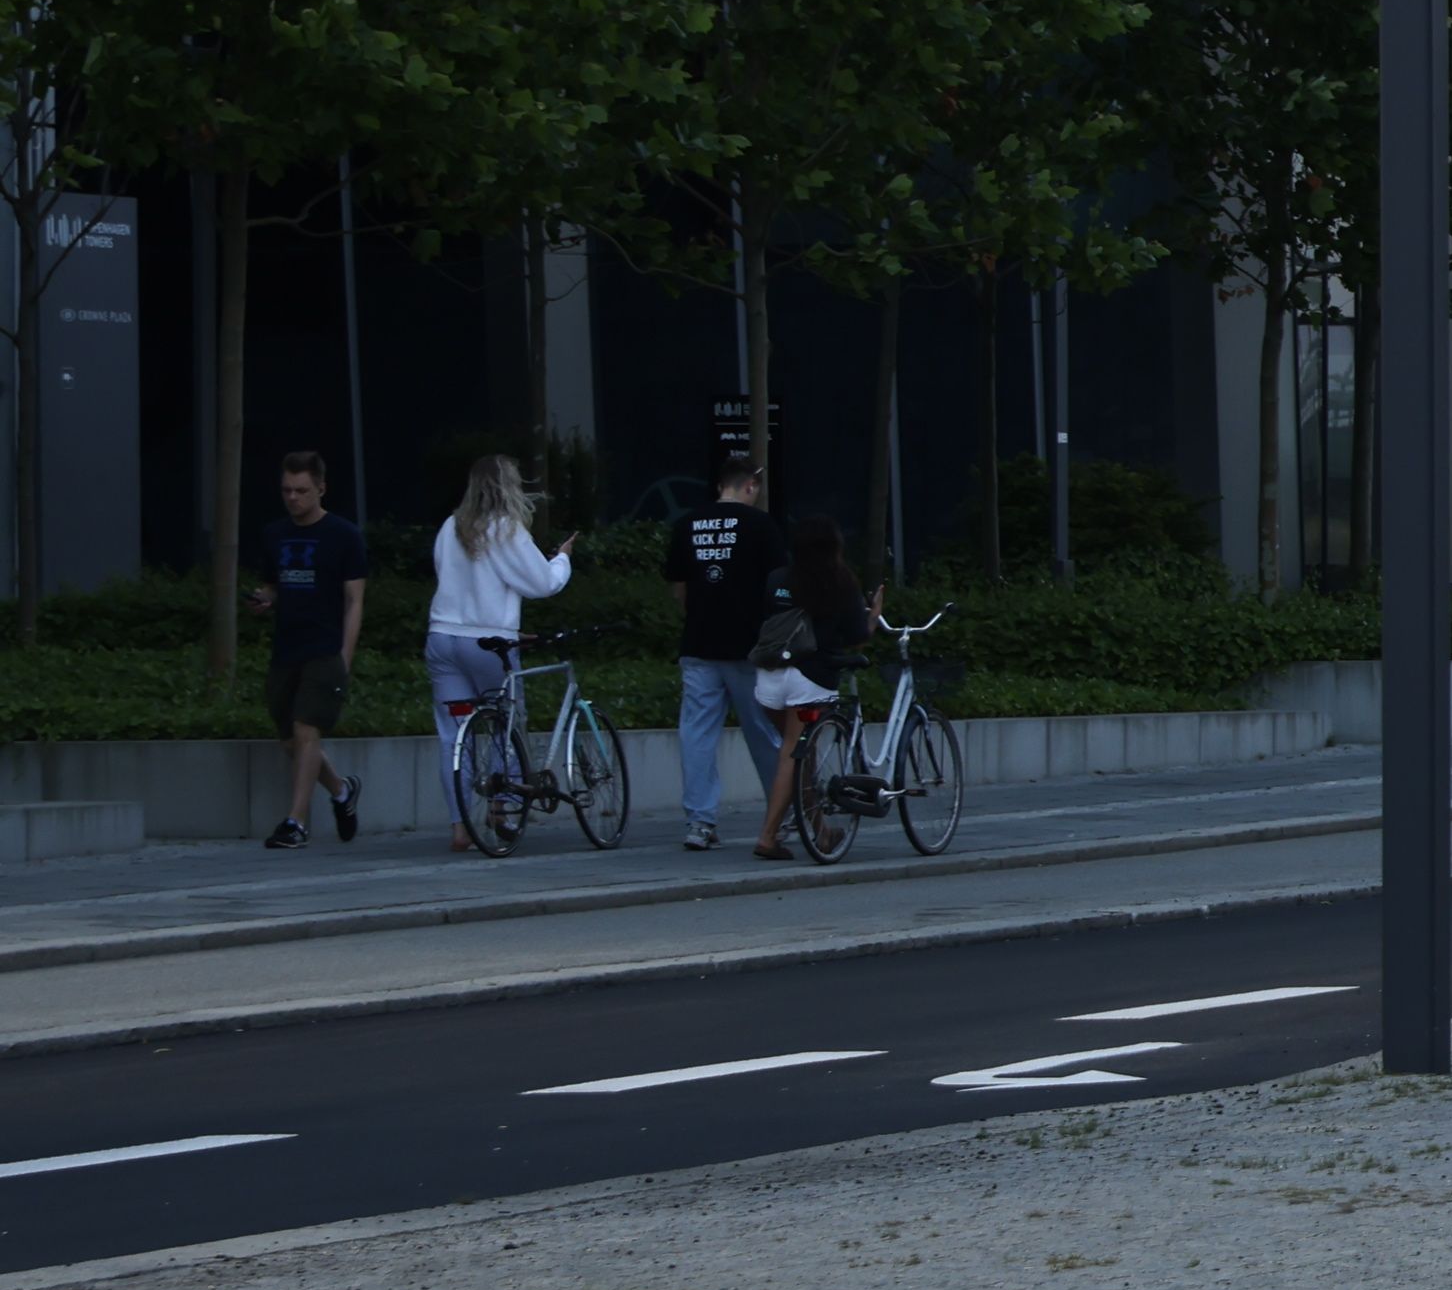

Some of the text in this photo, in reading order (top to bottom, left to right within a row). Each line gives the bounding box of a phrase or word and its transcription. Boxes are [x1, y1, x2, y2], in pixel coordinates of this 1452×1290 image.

[692, 518, 738, 531] WAKE UP
[692, 532, 737, 545] KICK ASS
[696, 547, 732, 560] REPEAT
